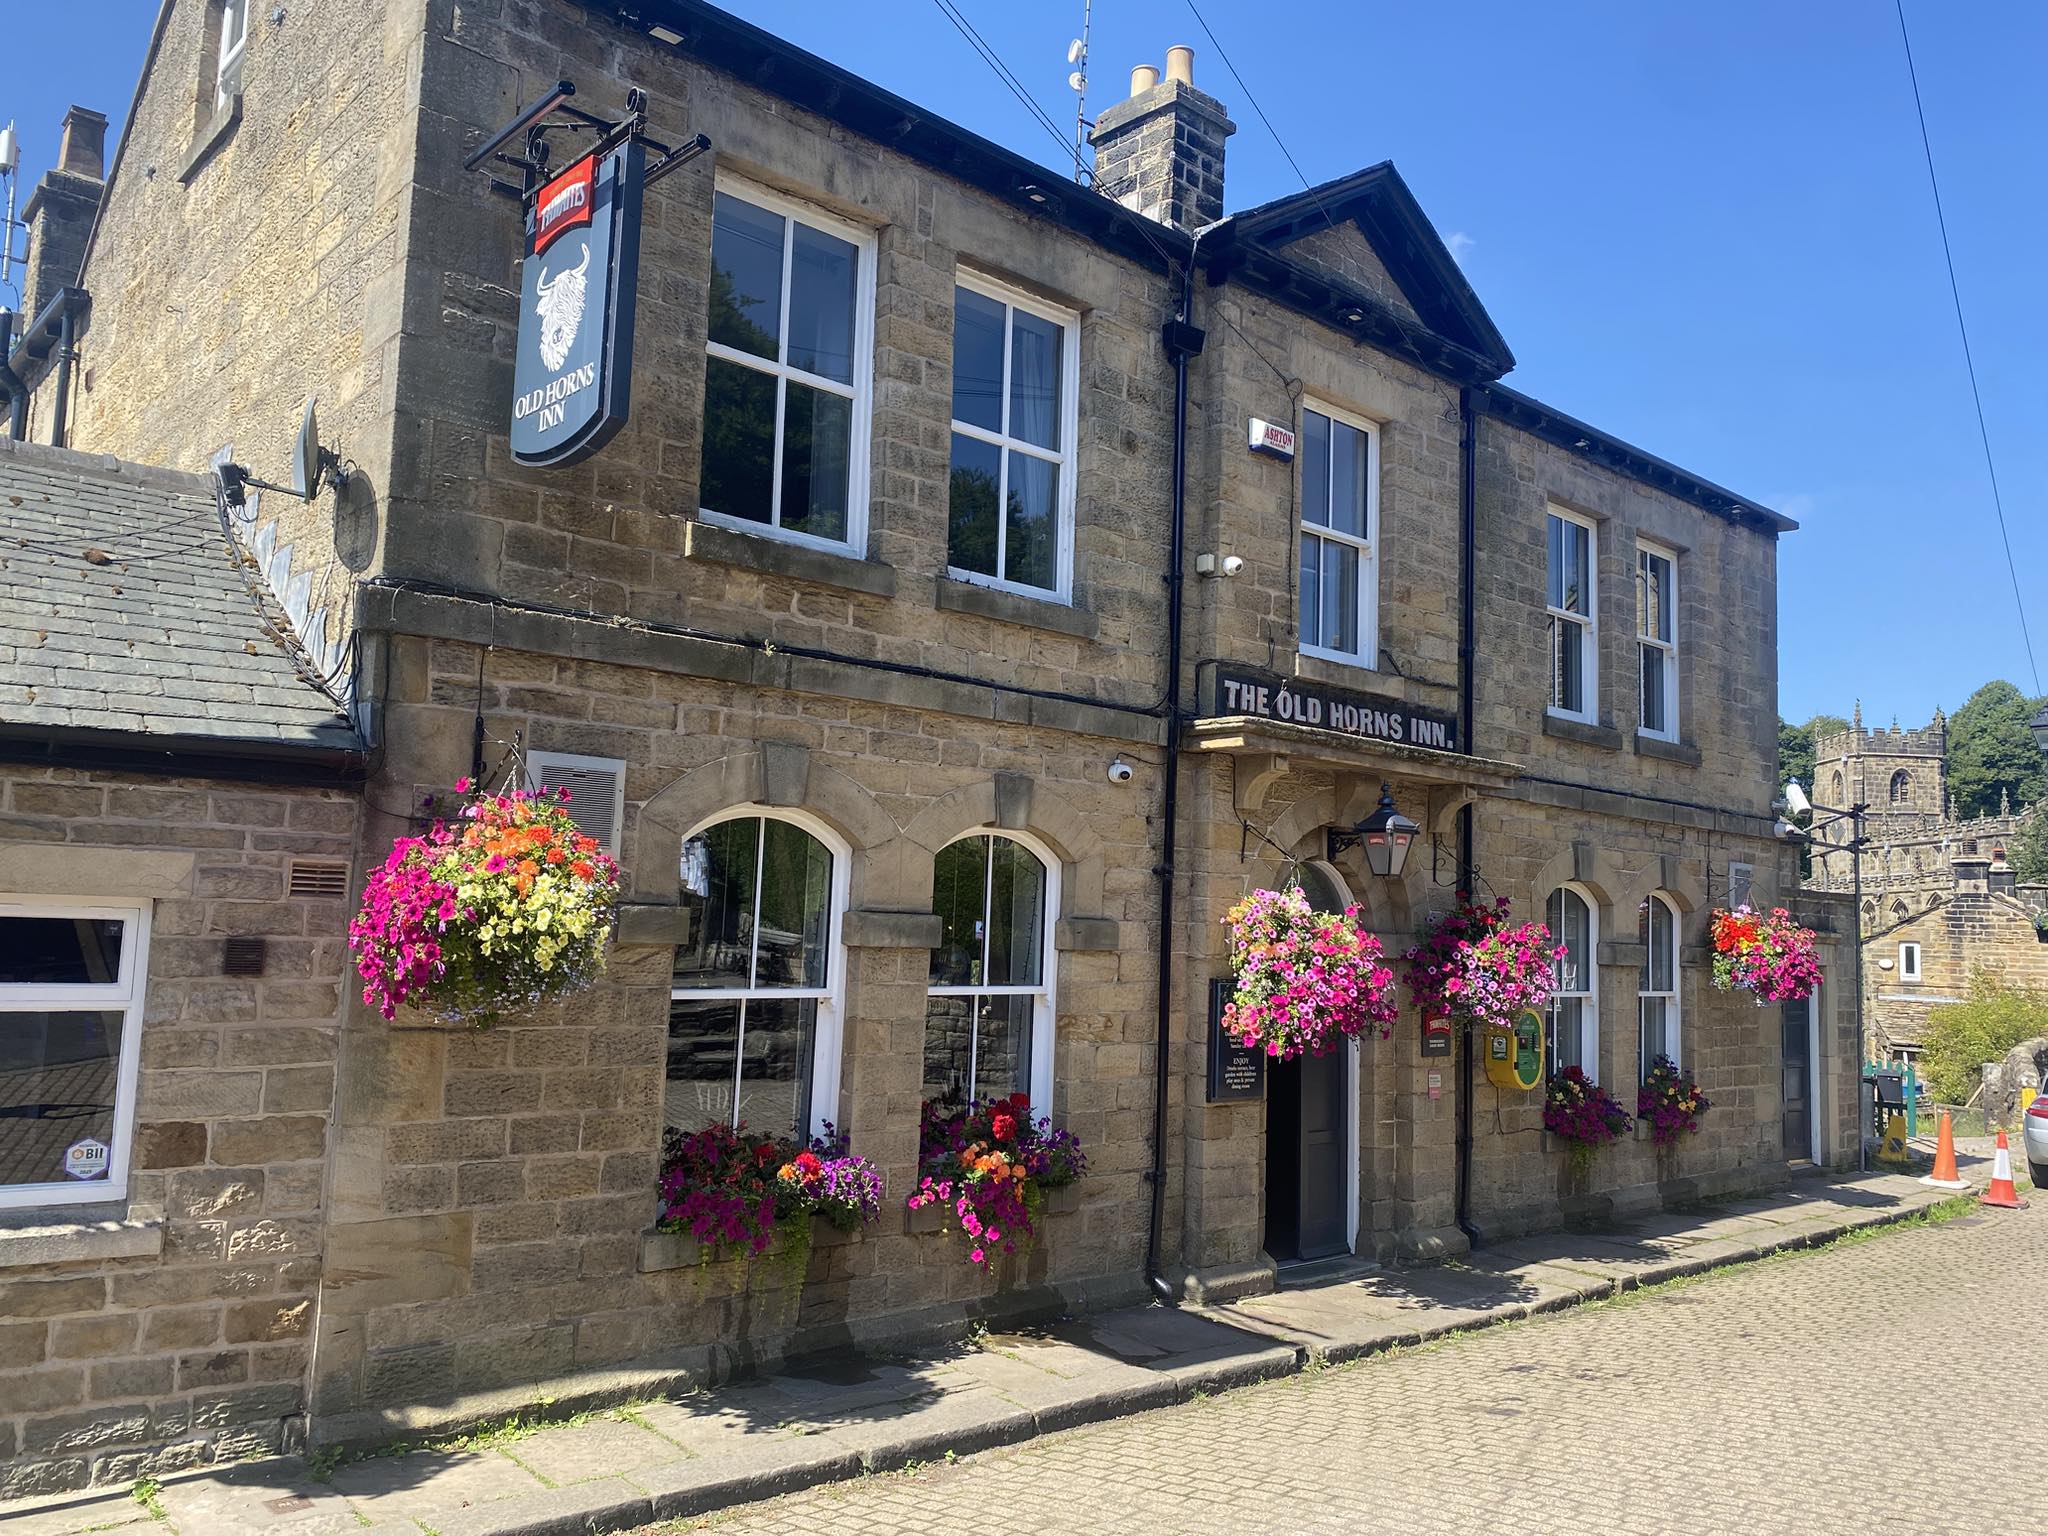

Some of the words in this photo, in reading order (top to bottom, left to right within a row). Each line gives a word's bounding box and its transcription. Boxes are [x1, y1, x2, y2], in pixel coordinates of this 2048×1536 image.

[515, 389, 544, 419] OLD
[545, 362, 594, 406] HORNS
[538, 400, 566, 433] INN
[1264, 426, 1293, 446] ASHTON
[1224, 679, 1270, 715] THE
[1276, 690, 1322, 725] OLD
[1329, 701, 1403, 740] HORNS
[1410, 717, 1454, 749] INN.
